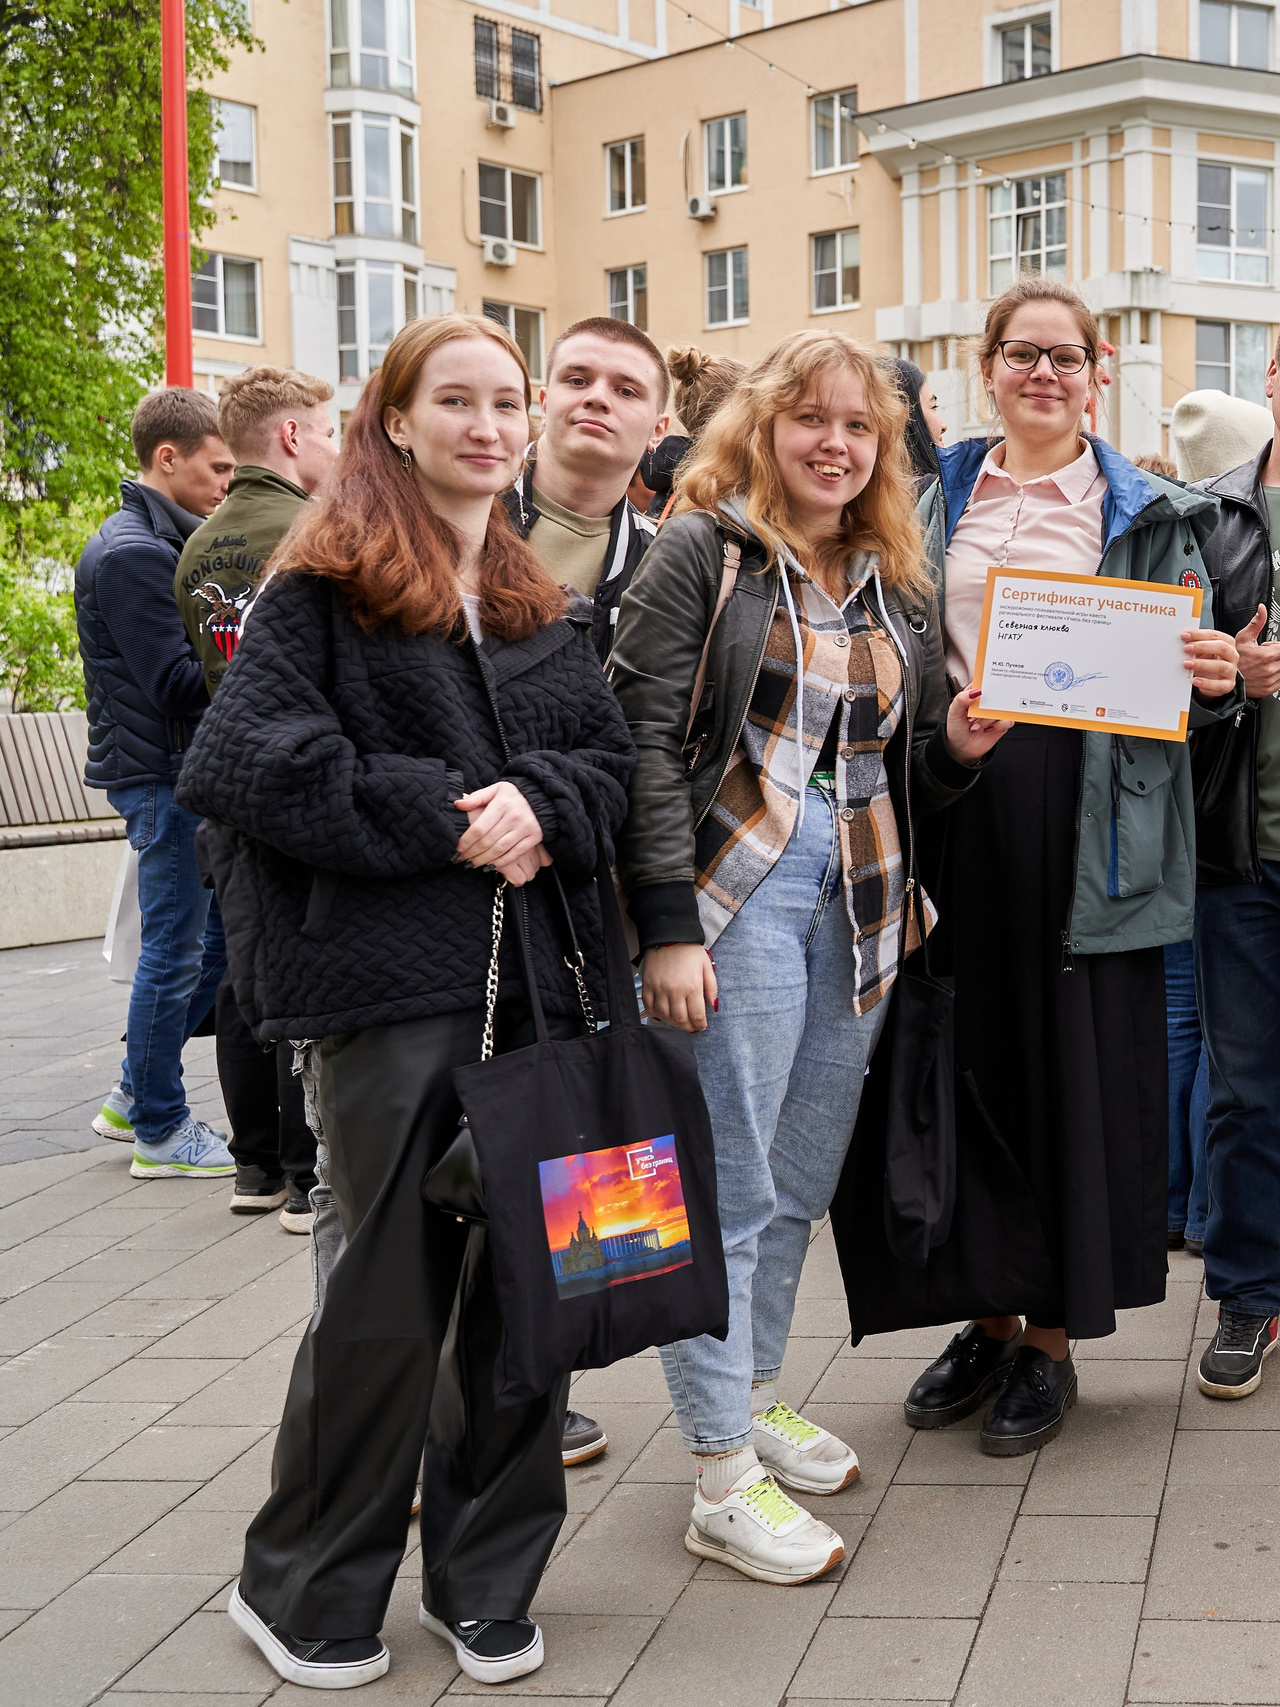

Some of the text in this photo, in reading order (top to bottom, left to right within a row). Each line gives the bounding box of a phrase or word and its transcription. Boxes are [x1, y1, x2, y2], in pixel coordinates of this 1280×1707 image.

[1001, 587, 1177, 617] Сертификат участника
[998, 619, 1070, 633] Северная клюква
[997, 632, 1023, 641] НГАТУ
[652, 1157, 673, 1168] границ
